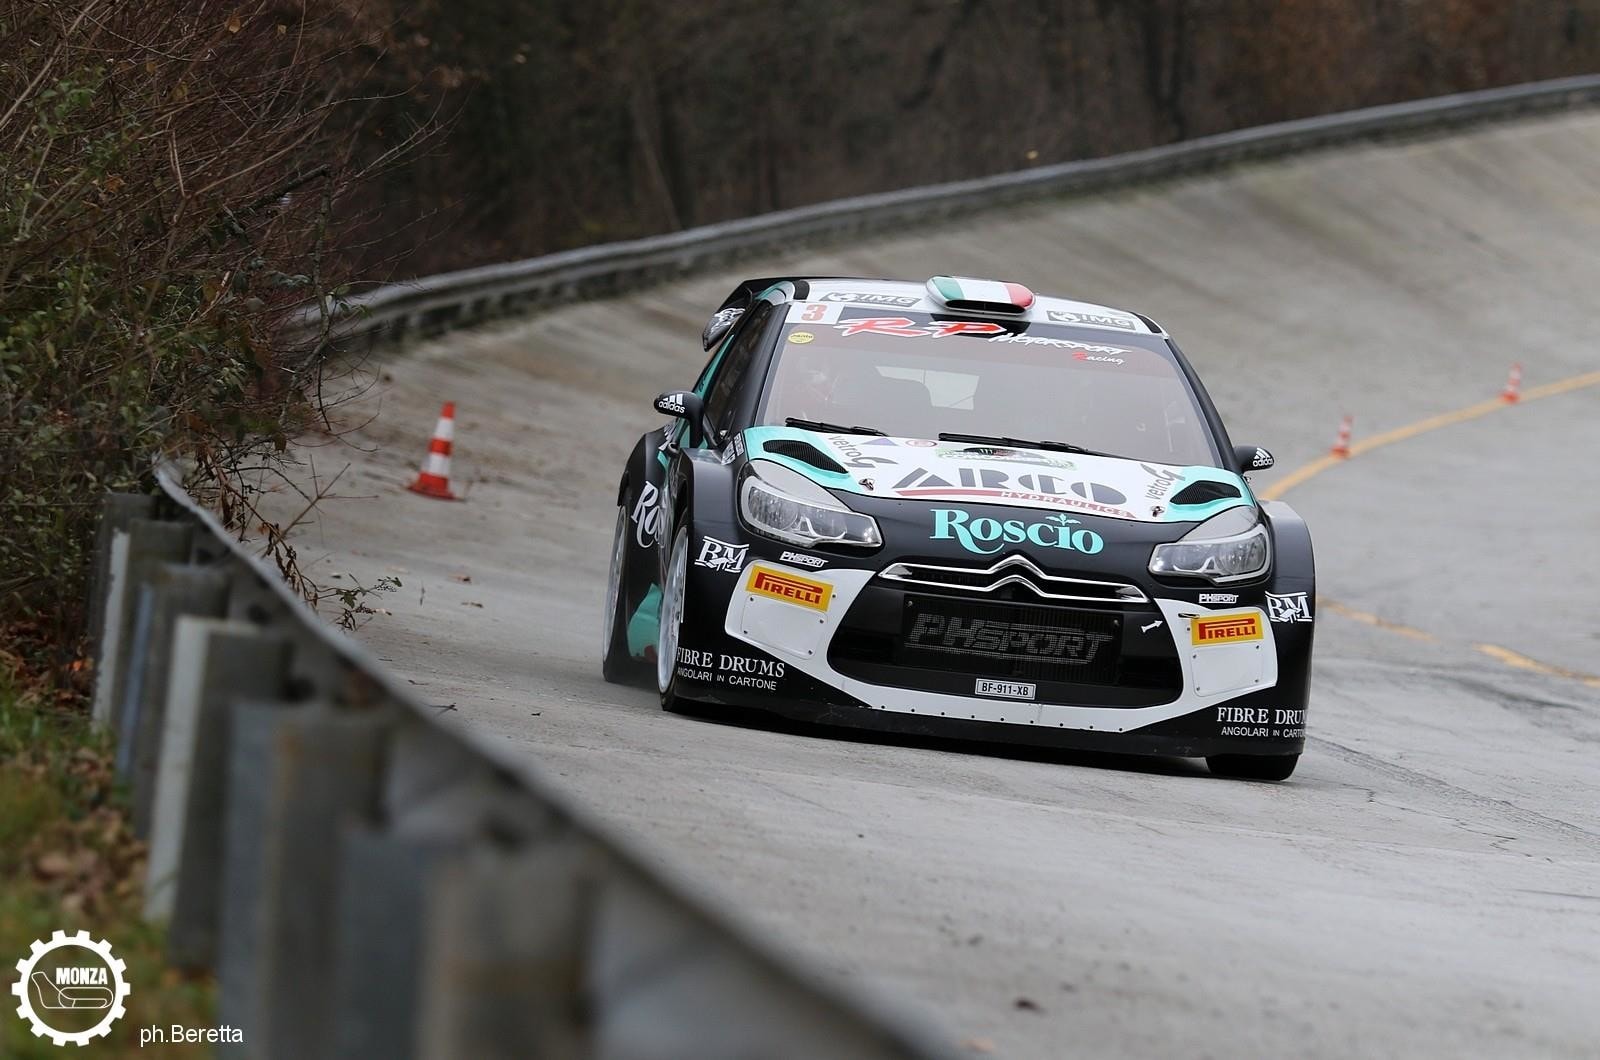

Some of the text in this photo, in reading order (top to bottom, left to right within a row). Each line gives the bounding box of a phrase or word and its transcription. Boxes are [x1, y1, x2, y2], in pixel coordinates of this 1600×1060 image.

[860, 294, 916, 304] IMG
[801, 304, 828, 321] 3
[1081, 313, 1130, 326] IMG
[658, 400, 686, 413] adidas
[891, 467, 1127, 505] ARCO
[929, 509, 1104, 554] Roscio
[695, 535, 750, 573] BM
[779, 550, 829, 568] PHSPORT
[754, 572, 824, 605] PIRELLI
[1265, 591, 1313, 624] BM
[904, 612, 1114, 665] PHSPORT
[1198, 617, 1257, 641] PIRELLI
[676, 646, 786, 679] FIBRE DRUMS
[677, 666, 777, 691] ANGOLARI IN CARTONE
[981, 682, 1029, 696] BF-911-XB
[1216, 706, 1305, 725] FIBRE DRU
[1220, 726, 1269, 737] ANGOLARI
[1272, 729, 1280, 737] IN
